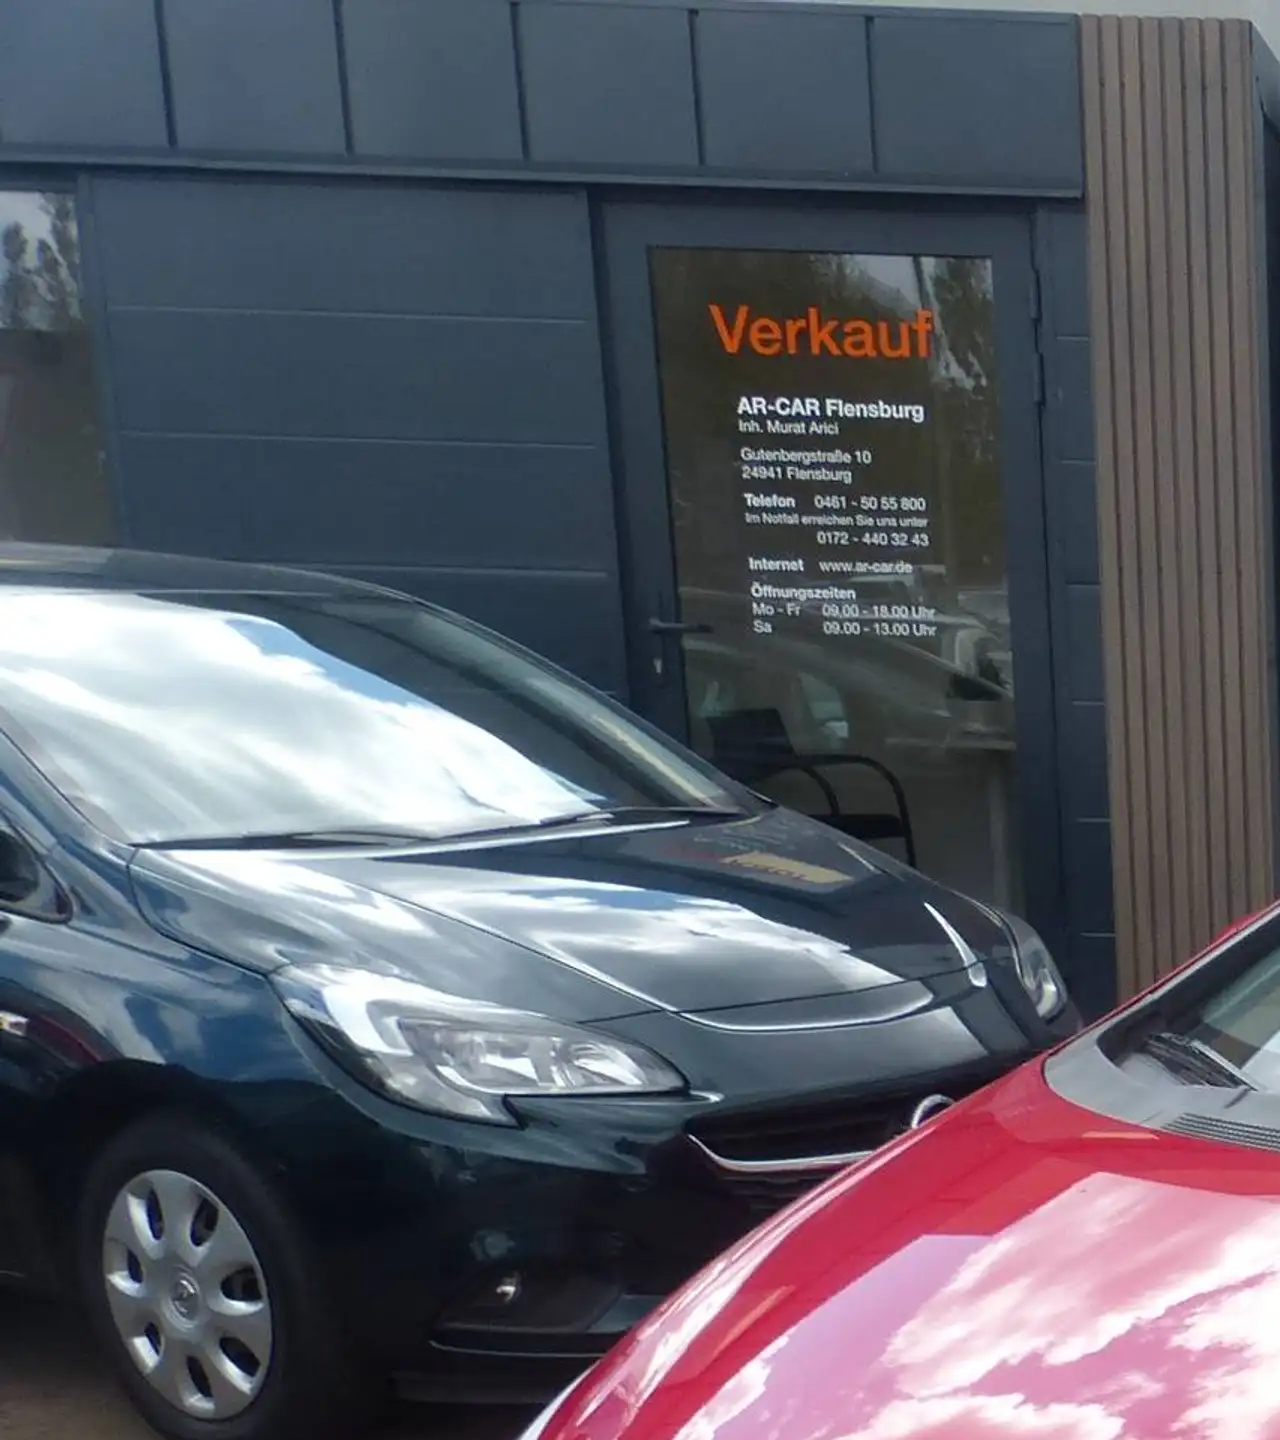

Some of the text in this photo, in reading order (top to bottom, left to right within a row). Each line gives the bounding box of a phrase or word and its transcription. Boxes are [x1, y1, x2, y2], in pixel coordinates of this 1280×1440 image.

[708, 304, 934, 358] Verkauf
[737, 397, 924, 422] AR-CAR Flensburg
[738, 420, 839, 435] Inh. Murat Arici
[740, 448, 872, 464] Gutenbergstraße 10
[742, 467, 852, 484] 24941 Flensburg
[743, 493, 796, 507] Telefon
[814, 495, 846, 509] 0461
[860, 496, 878, 510] 50
[900, 497, 926, 511] 800
[745, 513, 761, 524] Im
[762, 513, 799, 525] Notfall
[802, 514, 853, 526] erreichen
[856, 515, 874, 527] Sie
[899, 516, 929, 528] unter
[817, 532, 848, 545] 0172
[863, 532, 888, 546] 440
[890, 533, 908, 546] 32
[912, 533, 929, 547] 43
[749, 557, 913, 573] Internet www.ar-car.de
[751, 581, 856, 601] Öffnungszeiten
[752, 604, 775, 616] Mo
[787, 604, 801, 616] Fr
[872, 606, 908, 618] 18.00
[911, 606, 936, 619] Uhr
[753, 621, 772, 634] Sa
[875, 622, 909, 636] 13.00
[912, 623, 936, 636] Uhr
